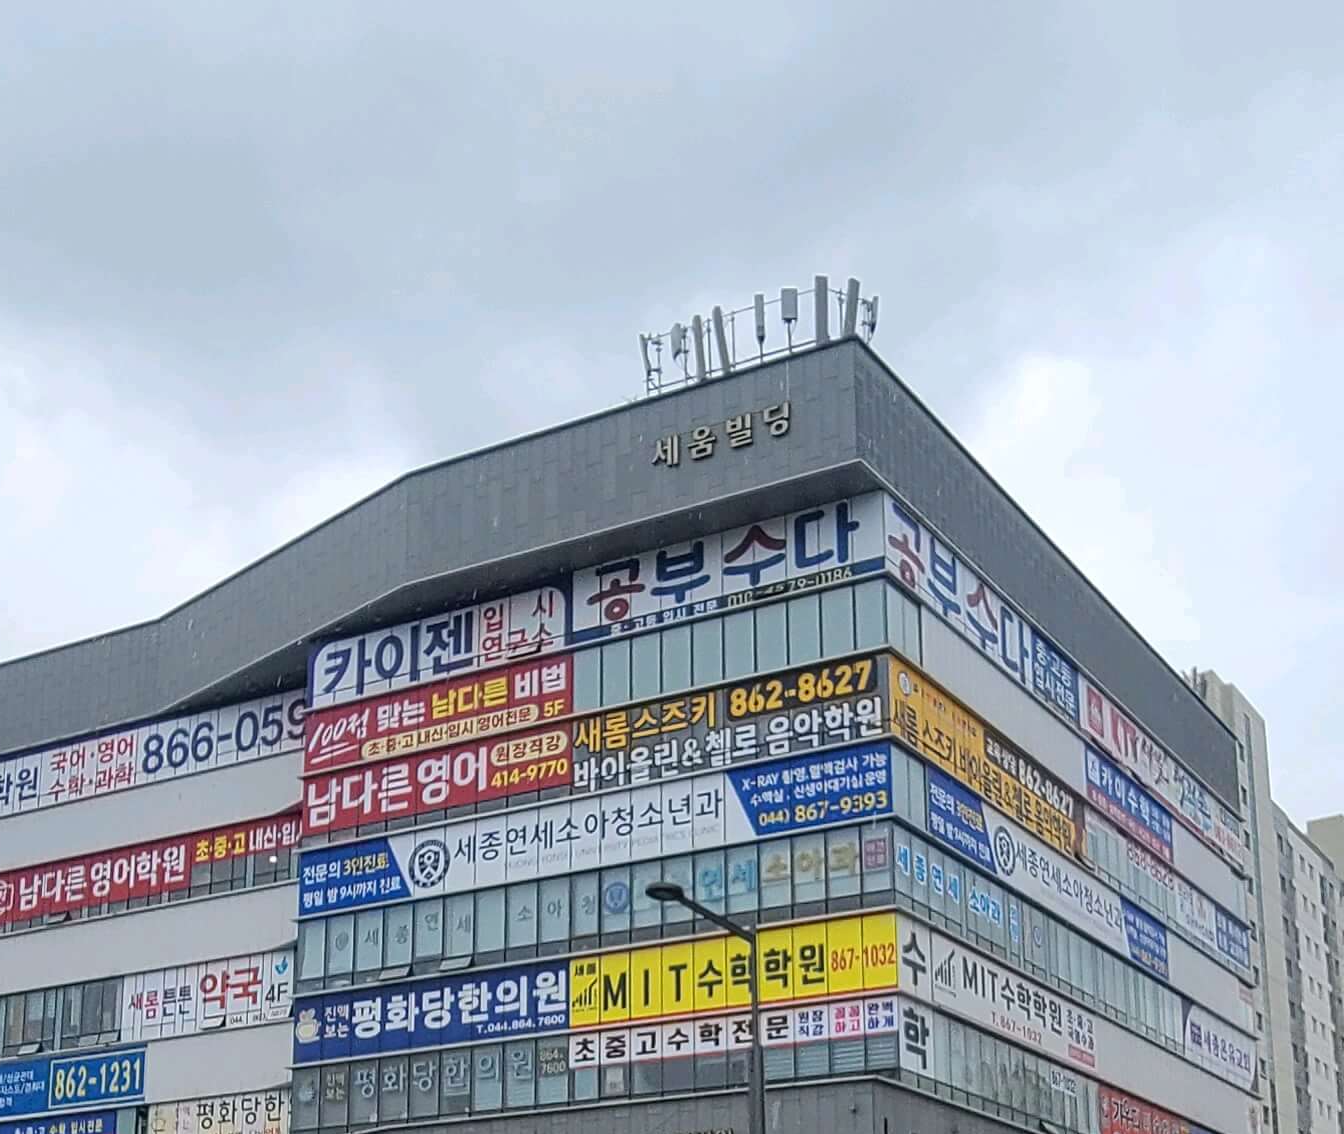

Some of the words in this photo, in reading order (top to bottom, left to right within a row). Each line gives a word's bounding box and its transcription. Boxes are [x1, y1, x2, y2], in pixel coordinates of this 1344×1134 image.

[651, 401, 791, 467] 세움빌딩
[586, 502, 861, 621] 공부수다
[323, 610, 474, 696] 카이젠
[431, 676, 508, 720] 남다른
[514, 662, 567, 700] 비법
[543, 699, 566, 718] 5F
[729, 658, 873, 719] 862-8627
[765, 695, 883, 754] 음악학원
[491, 758, 569, 788] 414-9770
[454, 788, 723, 865] 세종연세소아청소년과
[793, 789, 889, 823] 867-9393
[303, 859, 341, 883] 전문의
[199, 965, 264, 1010] 약국
[264, 982, 290, 1006] 4F
[830, 943, 896, 974] 867-1032
[351, 969, 568, 1040] 평화당한의원
[54, 1056, 143, 1100] 862-1231
